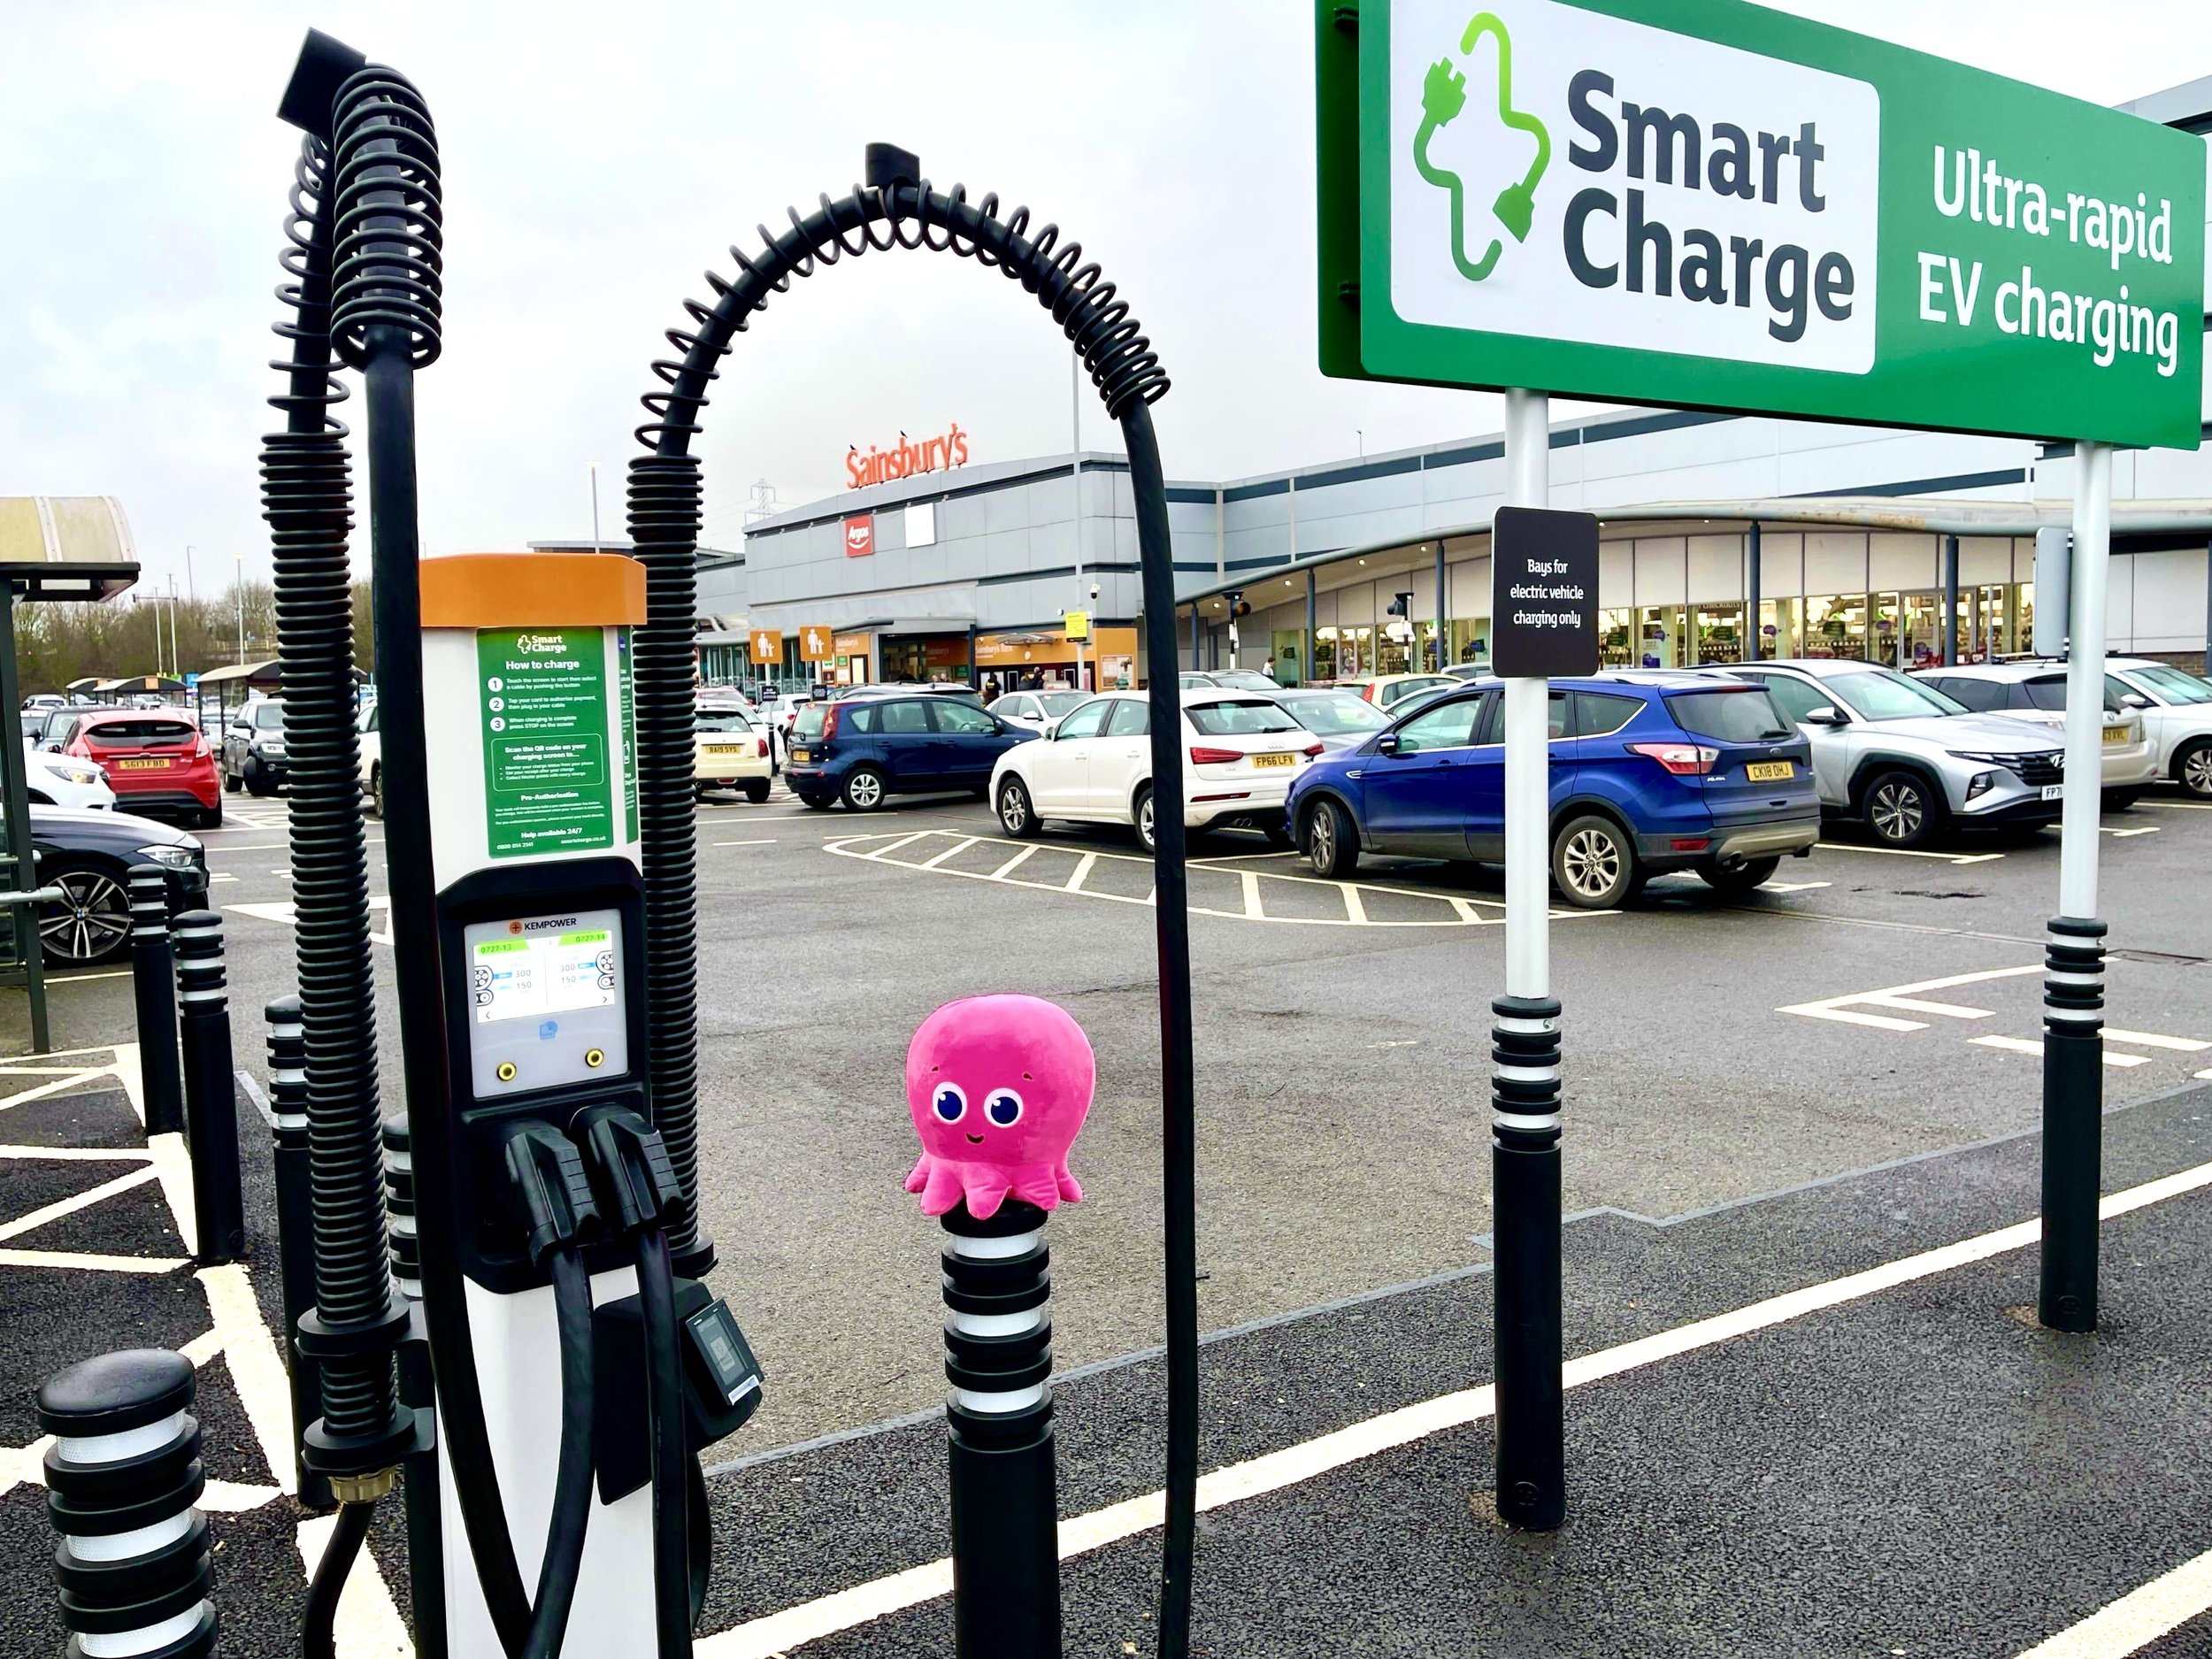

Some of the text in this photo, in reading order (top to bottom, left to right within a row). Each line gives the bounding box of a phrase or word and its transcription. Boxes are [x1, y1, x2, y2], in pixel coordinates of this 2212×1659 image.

[1568, 69, 1825, 212] Smart
[1934, 145, 2172, 270] Ultra-rapid
[1563, 188, 1854, 342] Charge
[1917, 251, 2177, 377] EV charging
[847, 423, 969, 488] Sainsbury's
[849, 526, 869, 541] Argos
[1527, 559, 1568, 577] Bays for
[1510, 584, 1584, 599] electric vehicle
[1513, 610, 1580, 628] charging only
[532, 643, 567, 653] Charge
[505, 661, 529, 670] How
[544, 660, 580, 670] charge
[1256, 755, 1293, 766] FP66 LFV
[1753, 764, 1789, 778] CK18 OHJ
[520, 791, 579, 801] Pre-Authorisation
[524, 918, 577, 931] KEMPOWER
[575, 933, 605, 943] 0727-14
[480, 944, 511, 954] 0727-13
[560, 964, 575, 972] 300
